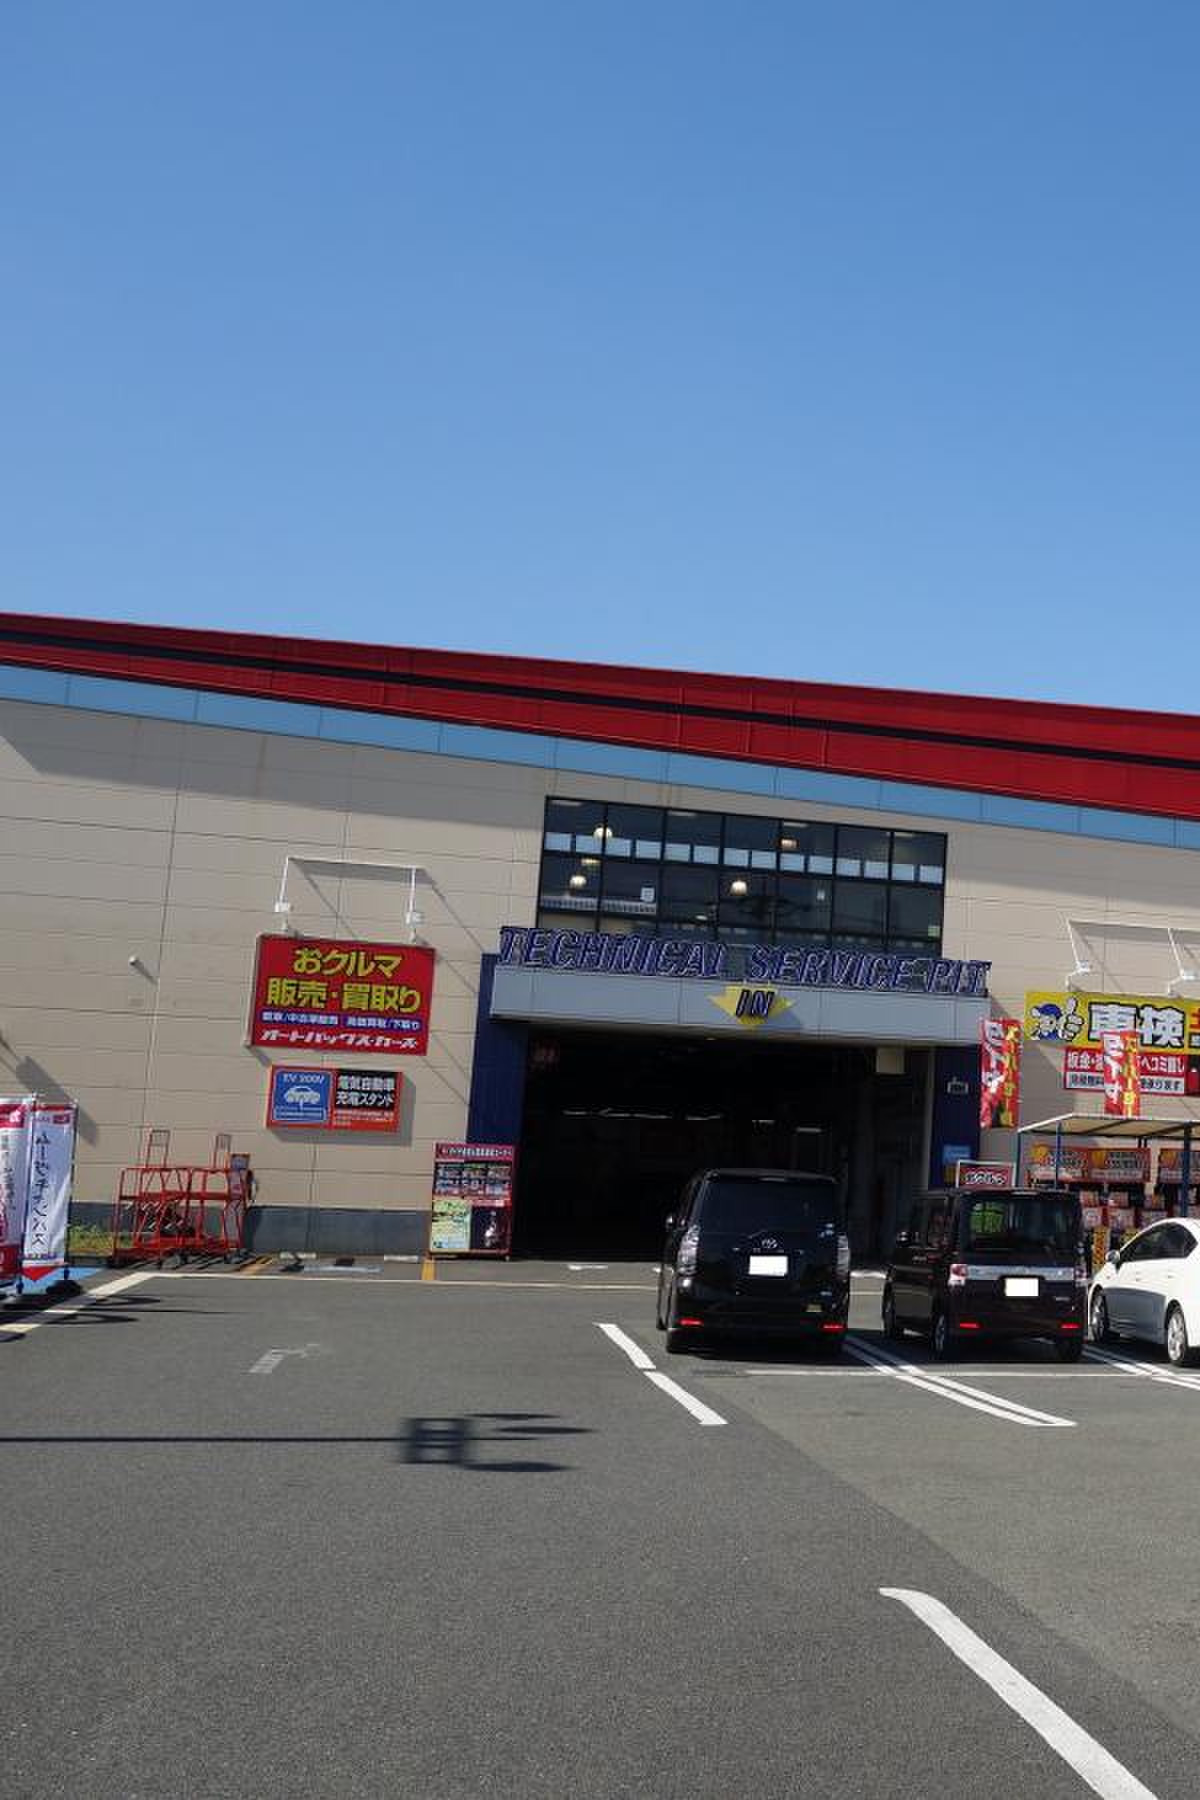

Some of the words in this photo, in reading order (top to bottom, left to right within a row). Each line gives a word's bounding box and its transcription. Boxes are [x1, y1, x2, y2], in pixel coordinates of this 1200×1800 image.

[294, 948, 403, 978] おクルマ
[500, 928, 725, 978] TECHNICAL
[747, 946, 917, 993] SERVICE
[921, 959, 992, 997] PIT
[266, 977, 421, 1014] 販売・買取り
[736, 988, 775, 1019] IN
